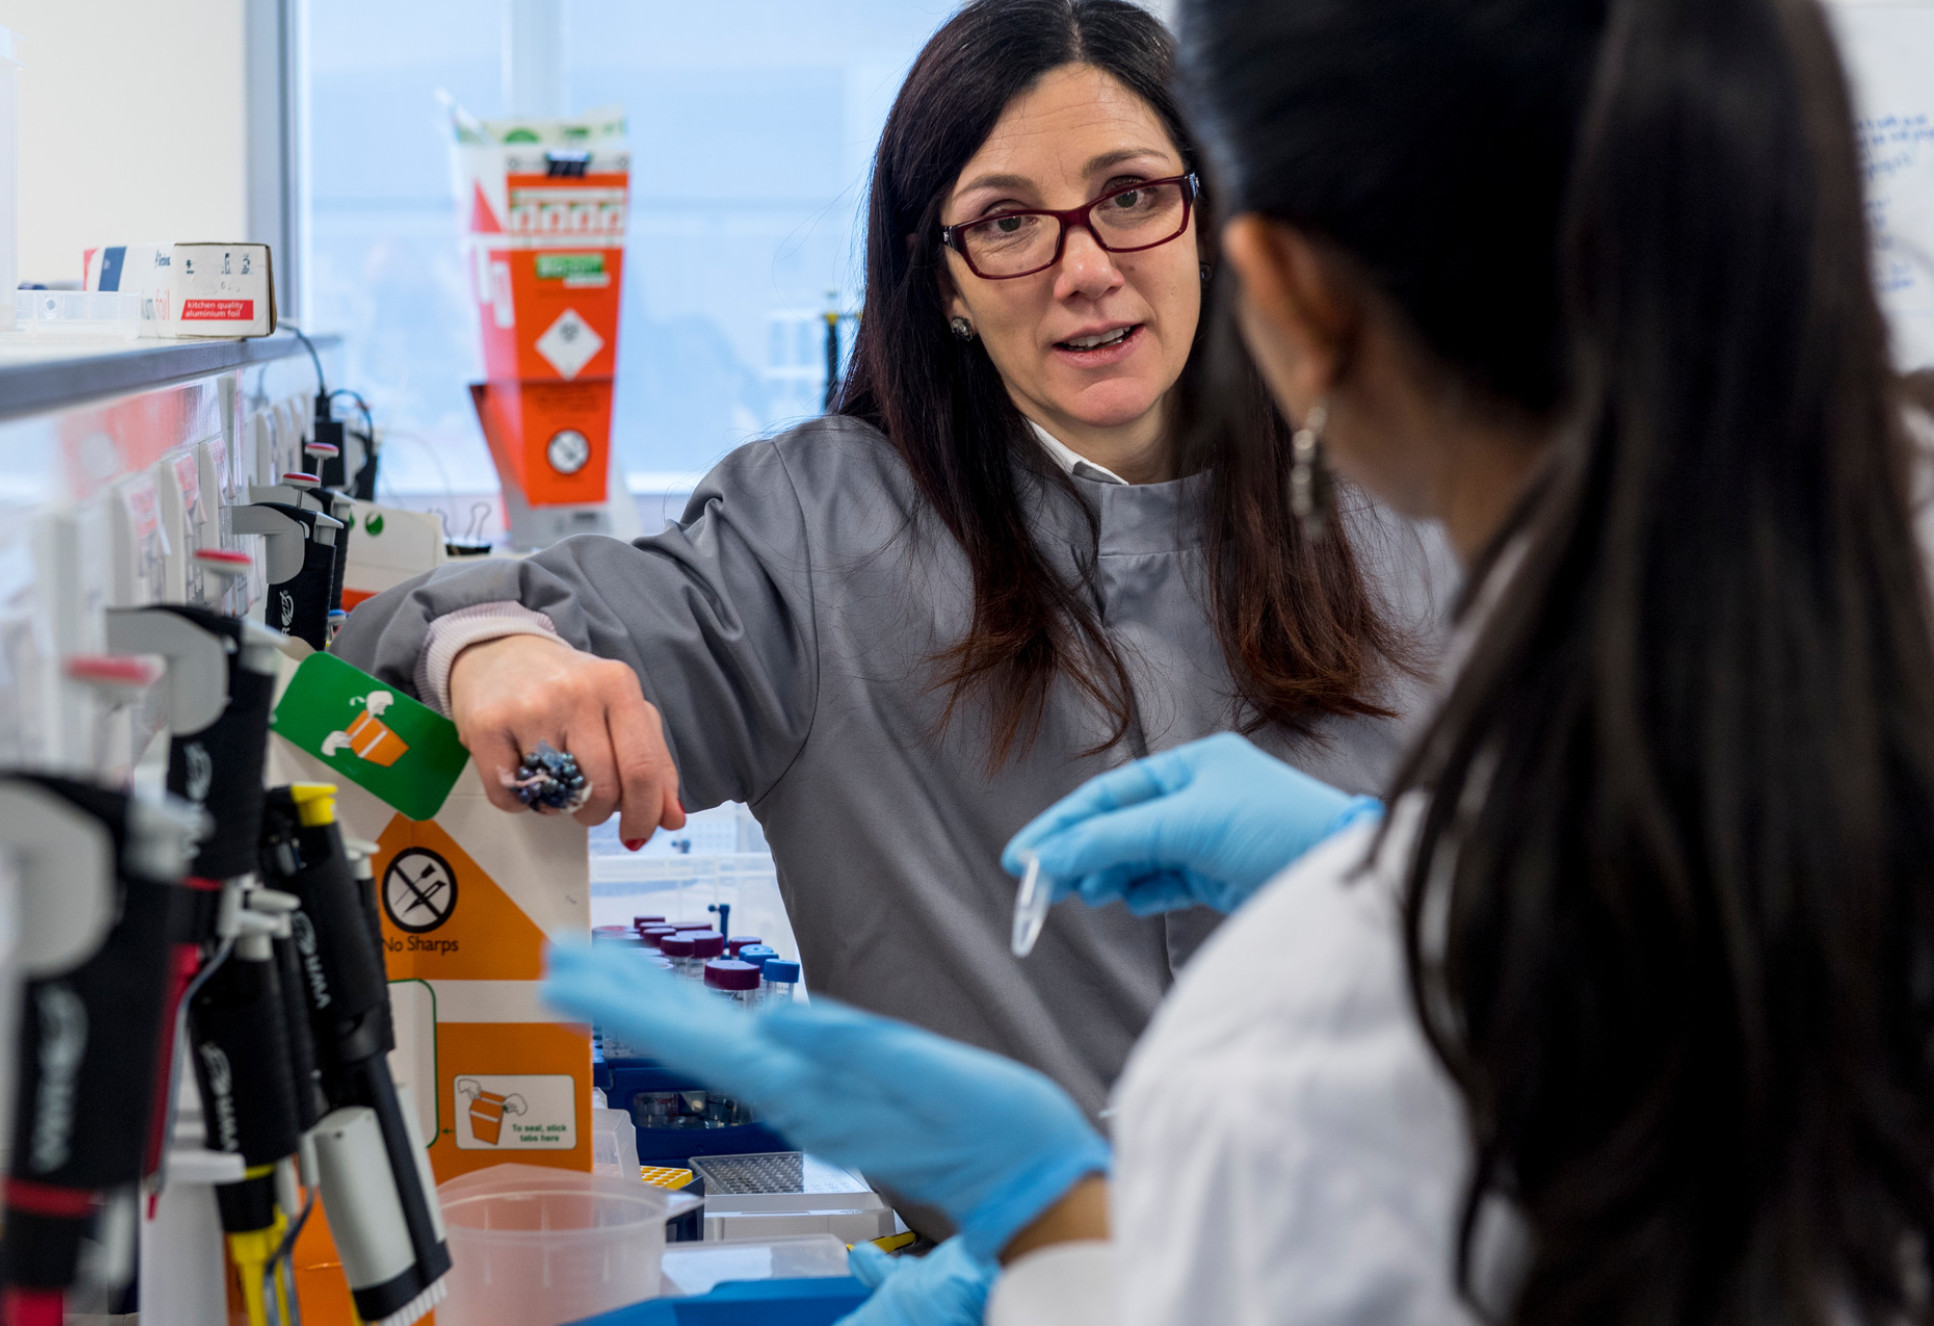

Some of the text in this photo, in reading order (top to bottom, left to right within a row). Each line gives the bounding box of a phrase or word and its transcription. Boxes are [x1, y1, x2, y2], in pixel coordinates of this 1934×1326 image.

[187, 300, 244, 311] kitchen quality
[185, 308, 241, 318] aluminium foil
[384, 935, 460, 956] No Sharps
[512, 1124, 567, 1132] To seal, stick
[519, 1134, 560, 1142] tabs here
